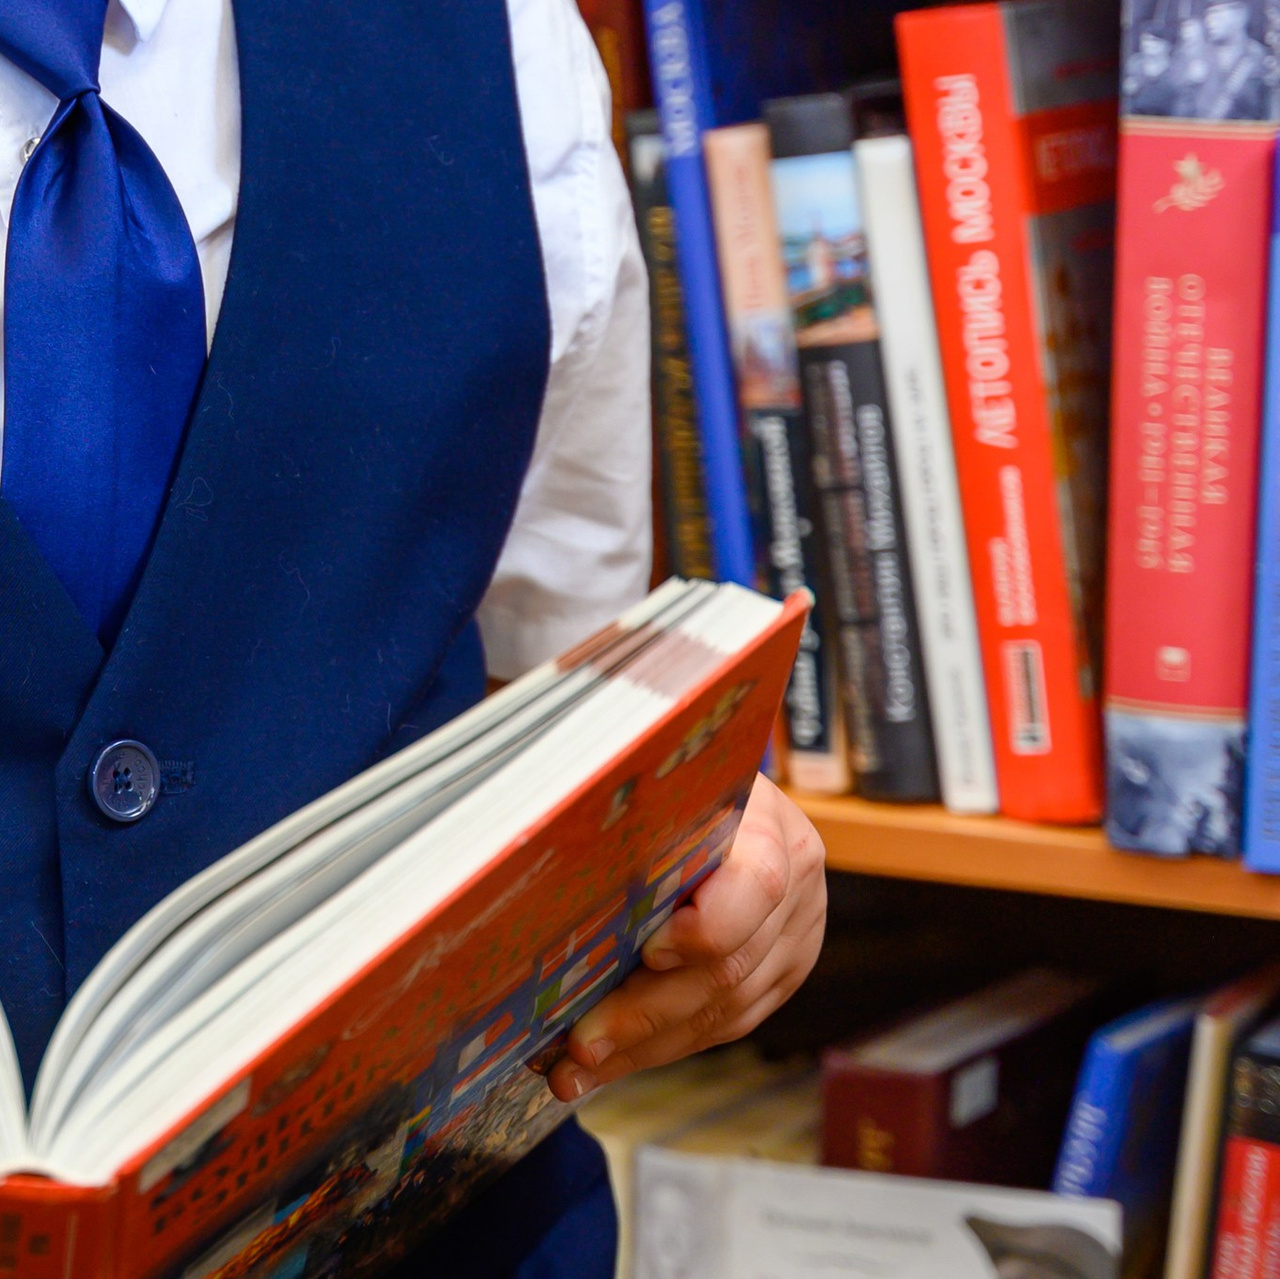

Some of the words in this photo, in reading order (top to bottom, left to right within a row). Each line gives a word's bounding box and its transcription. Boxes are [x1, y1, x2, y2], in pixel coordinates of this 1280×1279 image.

[651, 1, 697, 157] МОСКВА
[932, 73, 995, 244] МОСКВЫ
[955, 249, 1019, 449] ЛЕТОПИСЬ
[1139, 275, 1177, 397] ВОЙНА
[1167, 273, 1208, 574] ОТЕЧЕСТВЕННАЯ
[1200, 347, 1235, 505] ВЕЛИКАЯ
